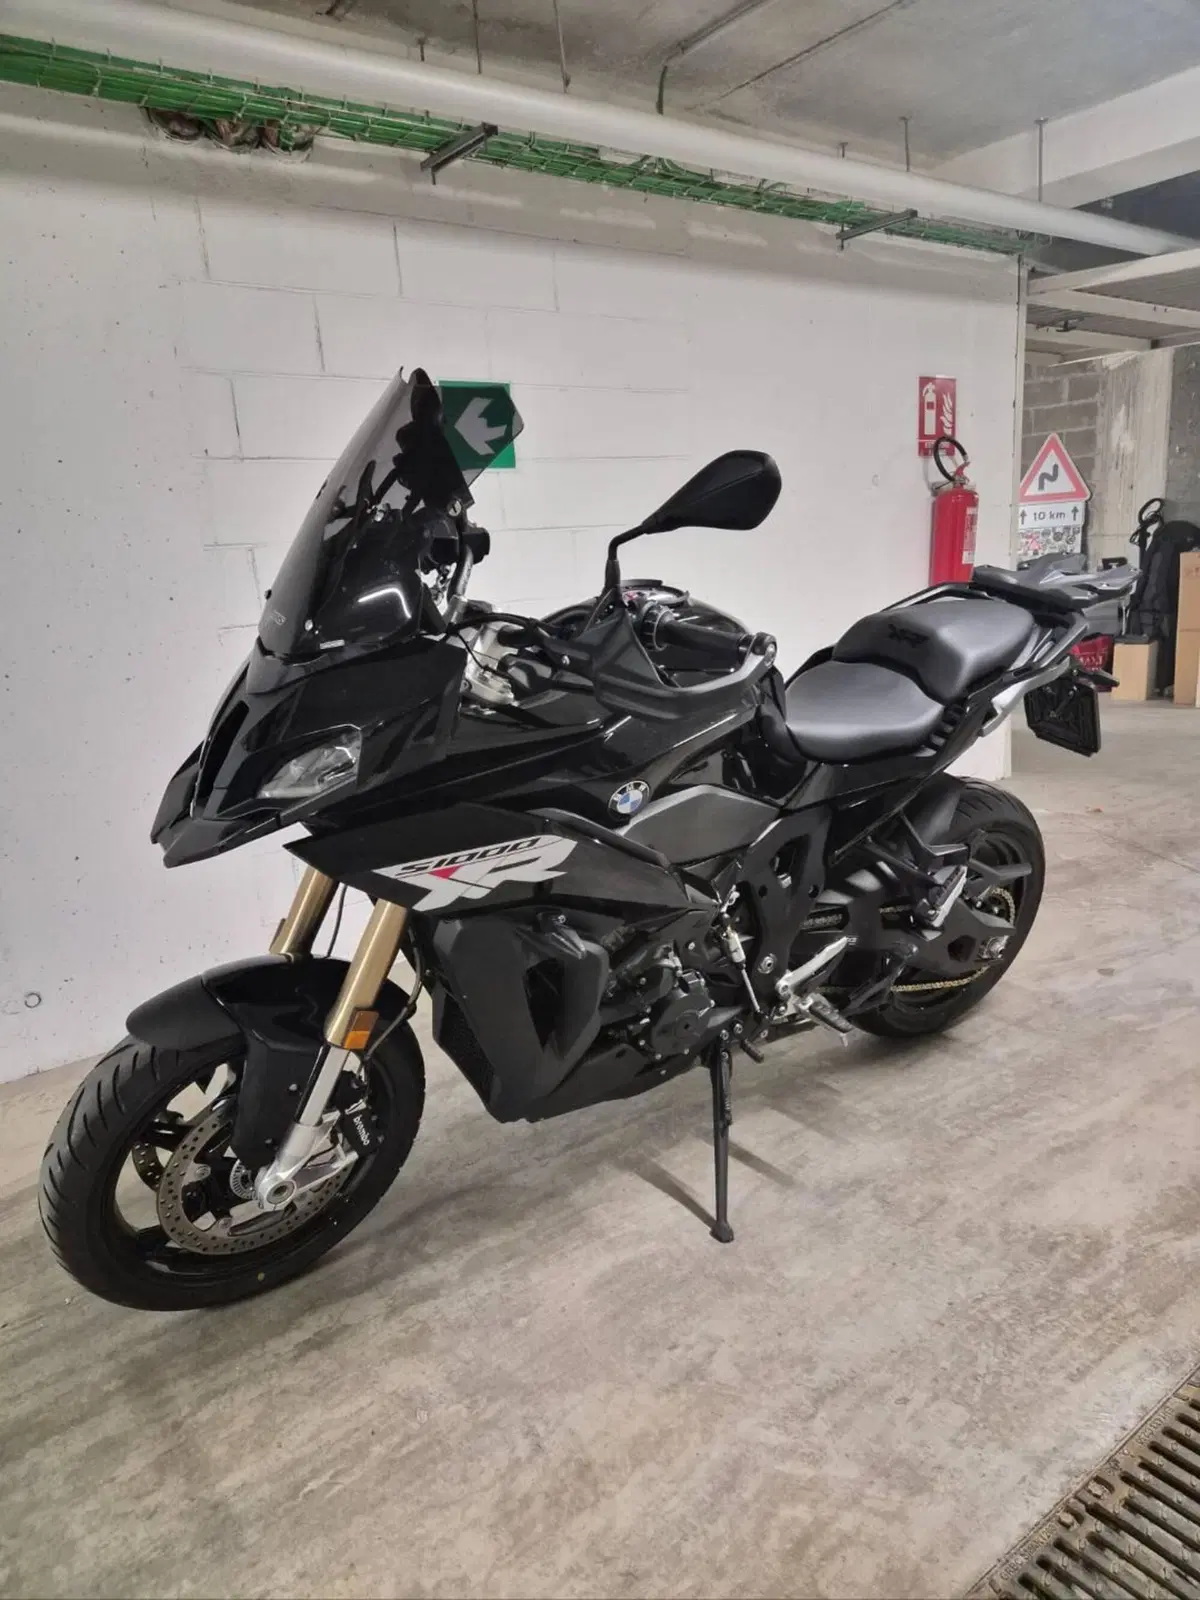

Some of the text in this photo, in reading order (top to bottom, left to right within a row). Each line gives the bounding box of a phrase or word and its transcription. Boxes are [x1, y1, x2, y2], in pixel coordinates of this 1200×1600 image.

[1033, 511, 1066, 521] 10 km
[395, 838, 541, 876] S1000
[353, 1114, 370, 1146] brembo
